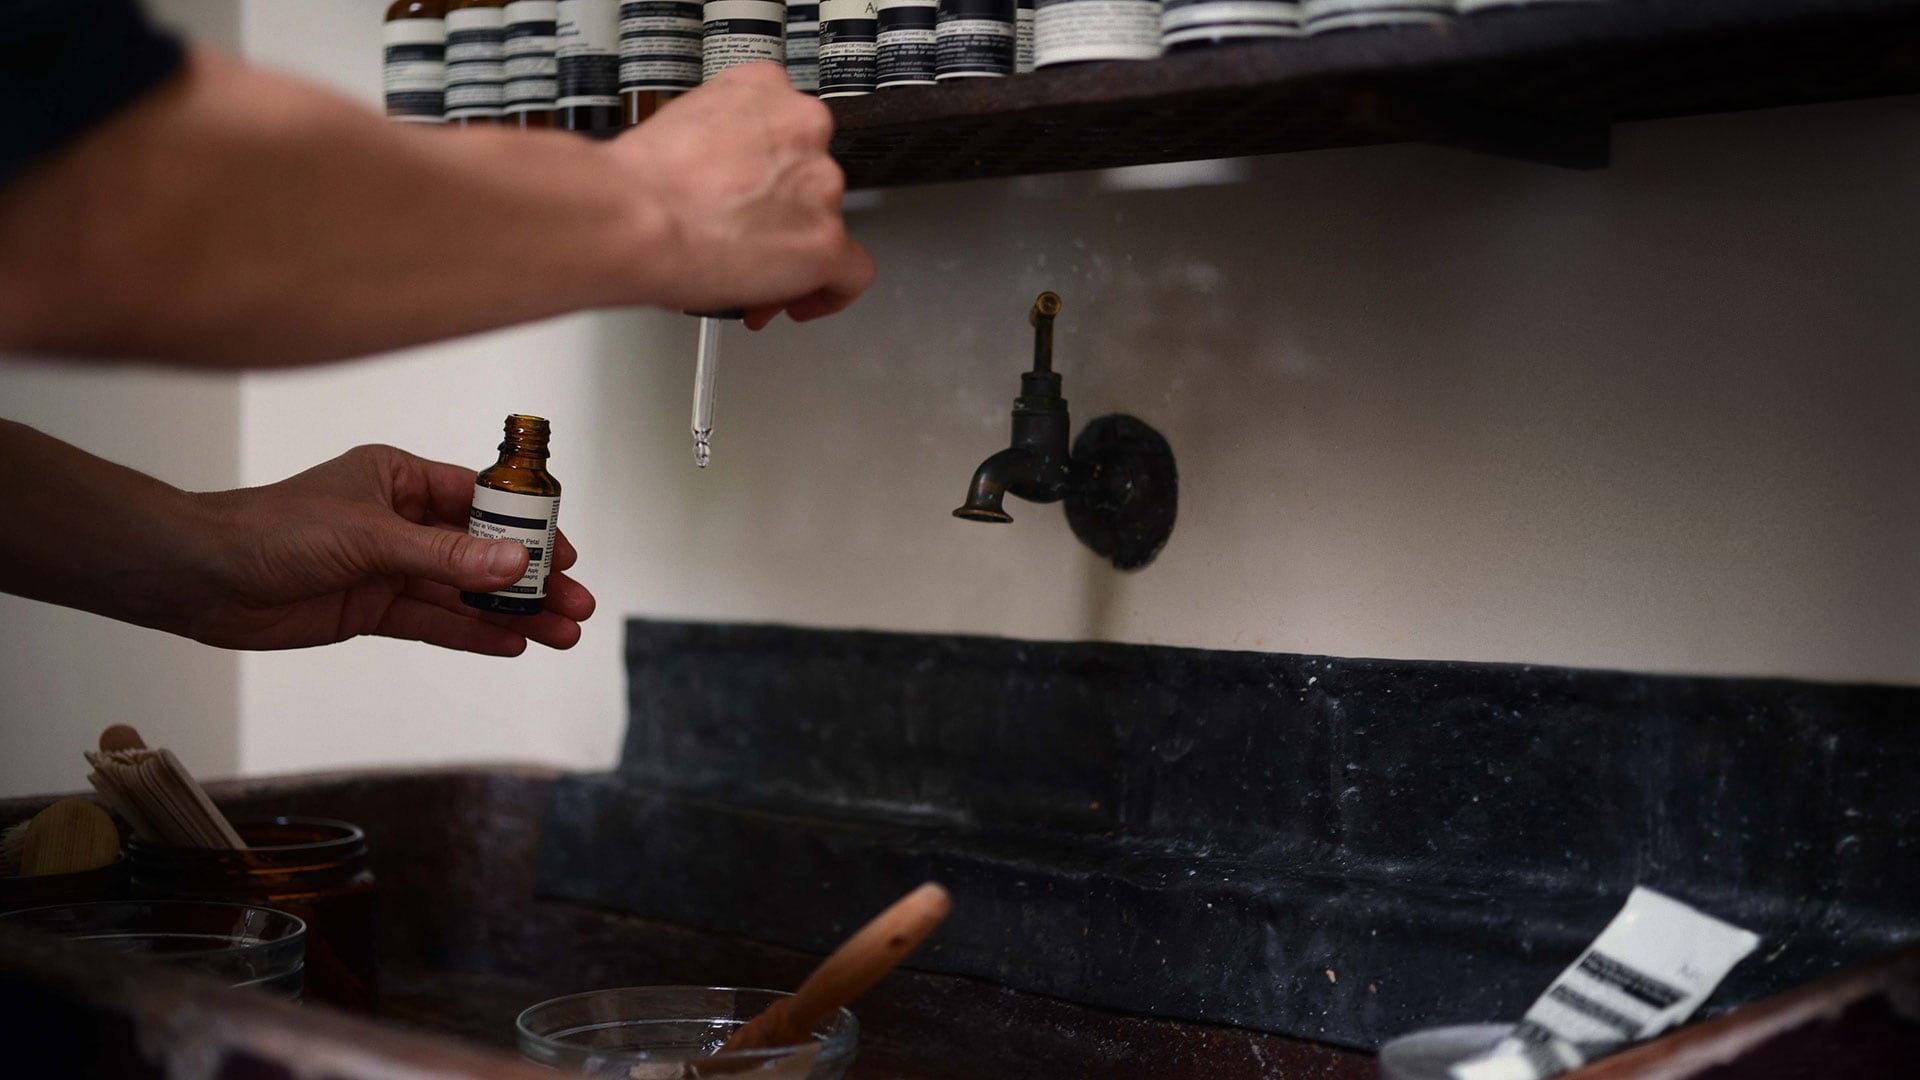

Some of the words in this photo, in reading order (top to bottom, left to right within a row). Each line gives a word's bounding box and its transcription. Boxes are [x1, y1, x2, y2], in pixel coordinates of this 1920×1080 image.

[865, 2, 877, 14] A
[487, 523, 506, 533] Visage
[525, 537, 540, 545] Petal
